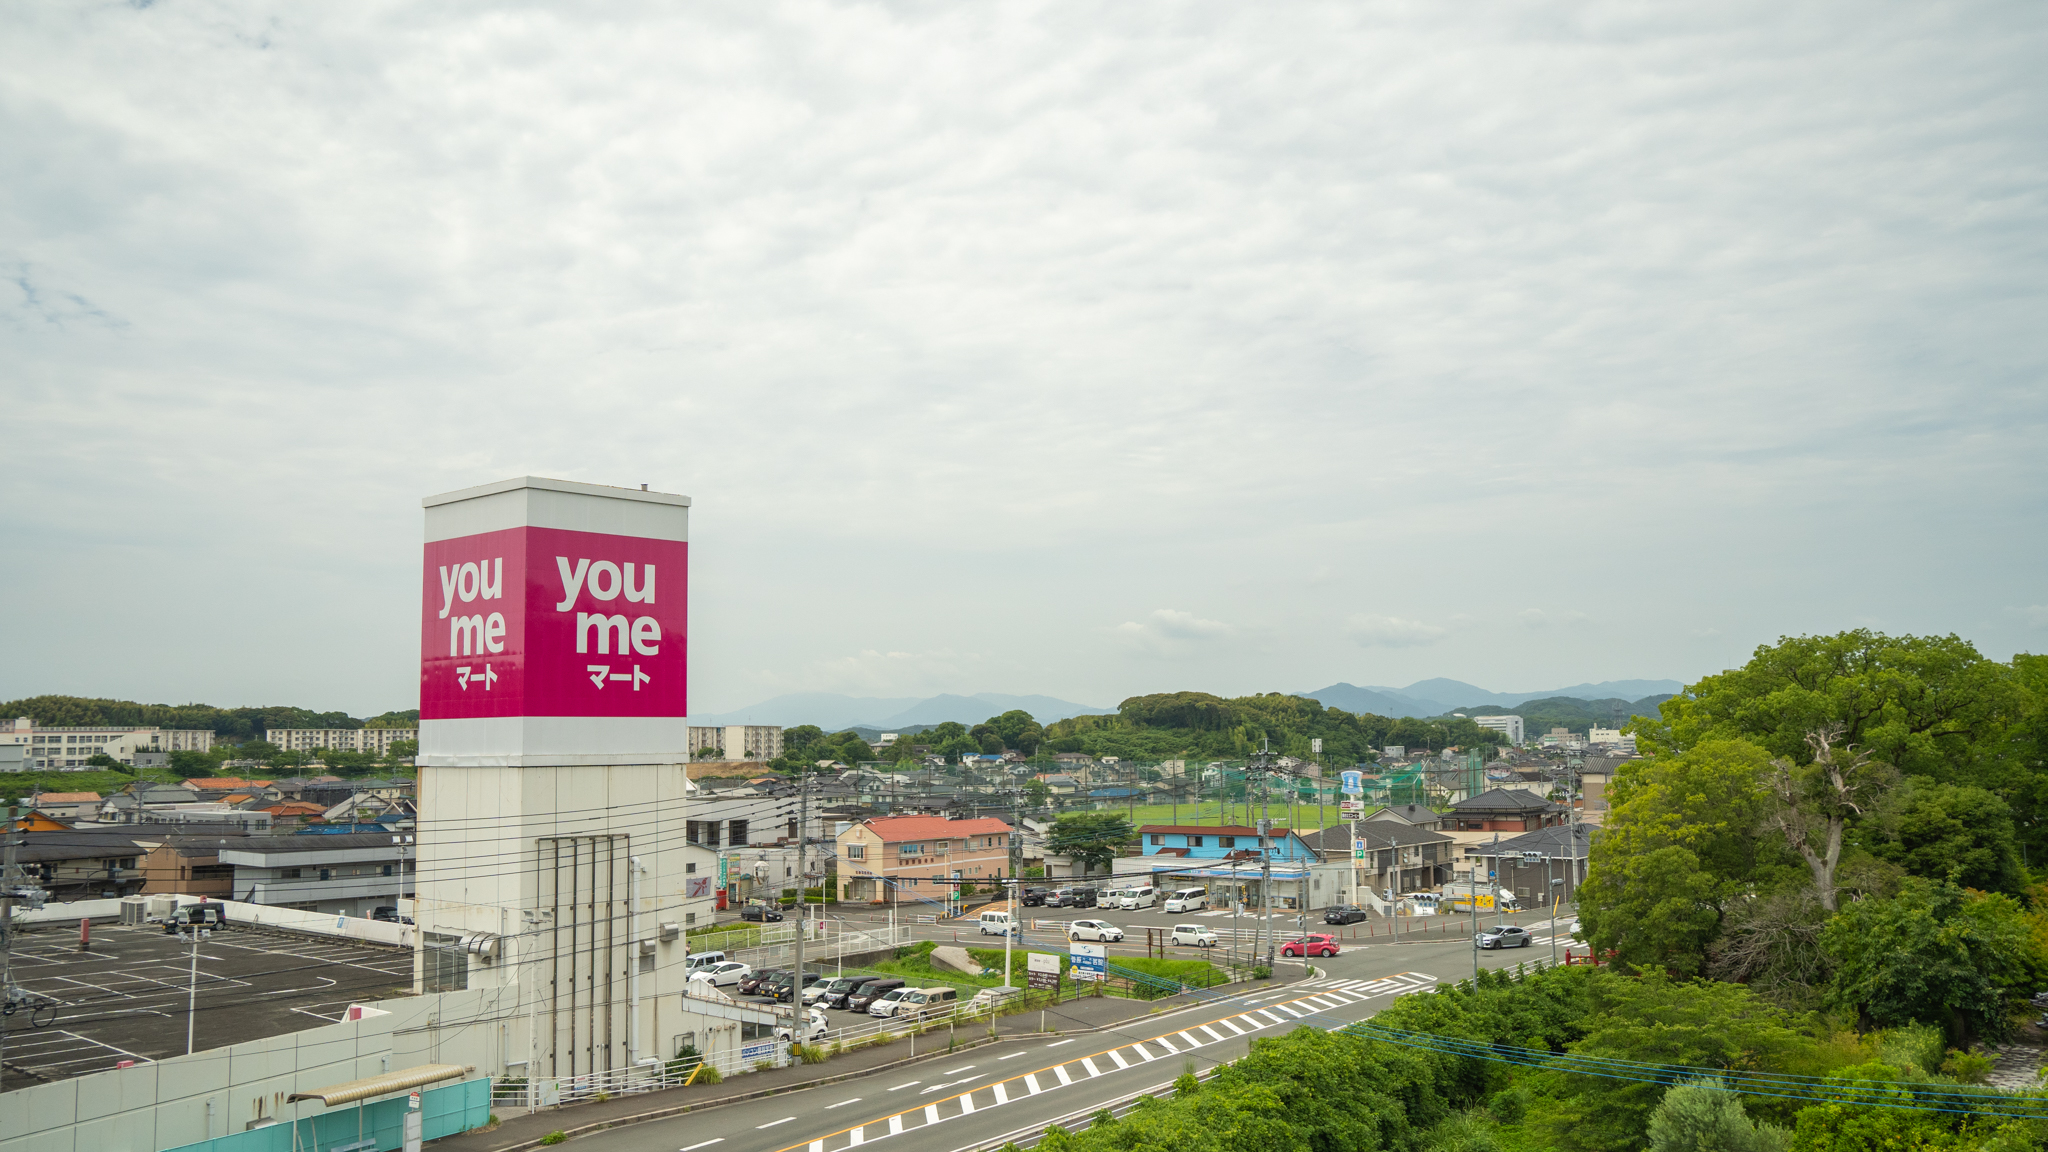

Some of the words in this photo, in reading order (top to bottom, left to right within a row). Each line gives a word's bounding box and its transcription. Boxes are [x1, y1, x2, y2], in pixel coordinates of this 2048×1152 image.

[439, 557, 502, 619] you
[555, 556, 655, 612] you
[450, 612, 506, 657] me
[576, 612, 662, 656] me
[456, 663, 498, 691] マート
[587, 664, 651, 691] マート
